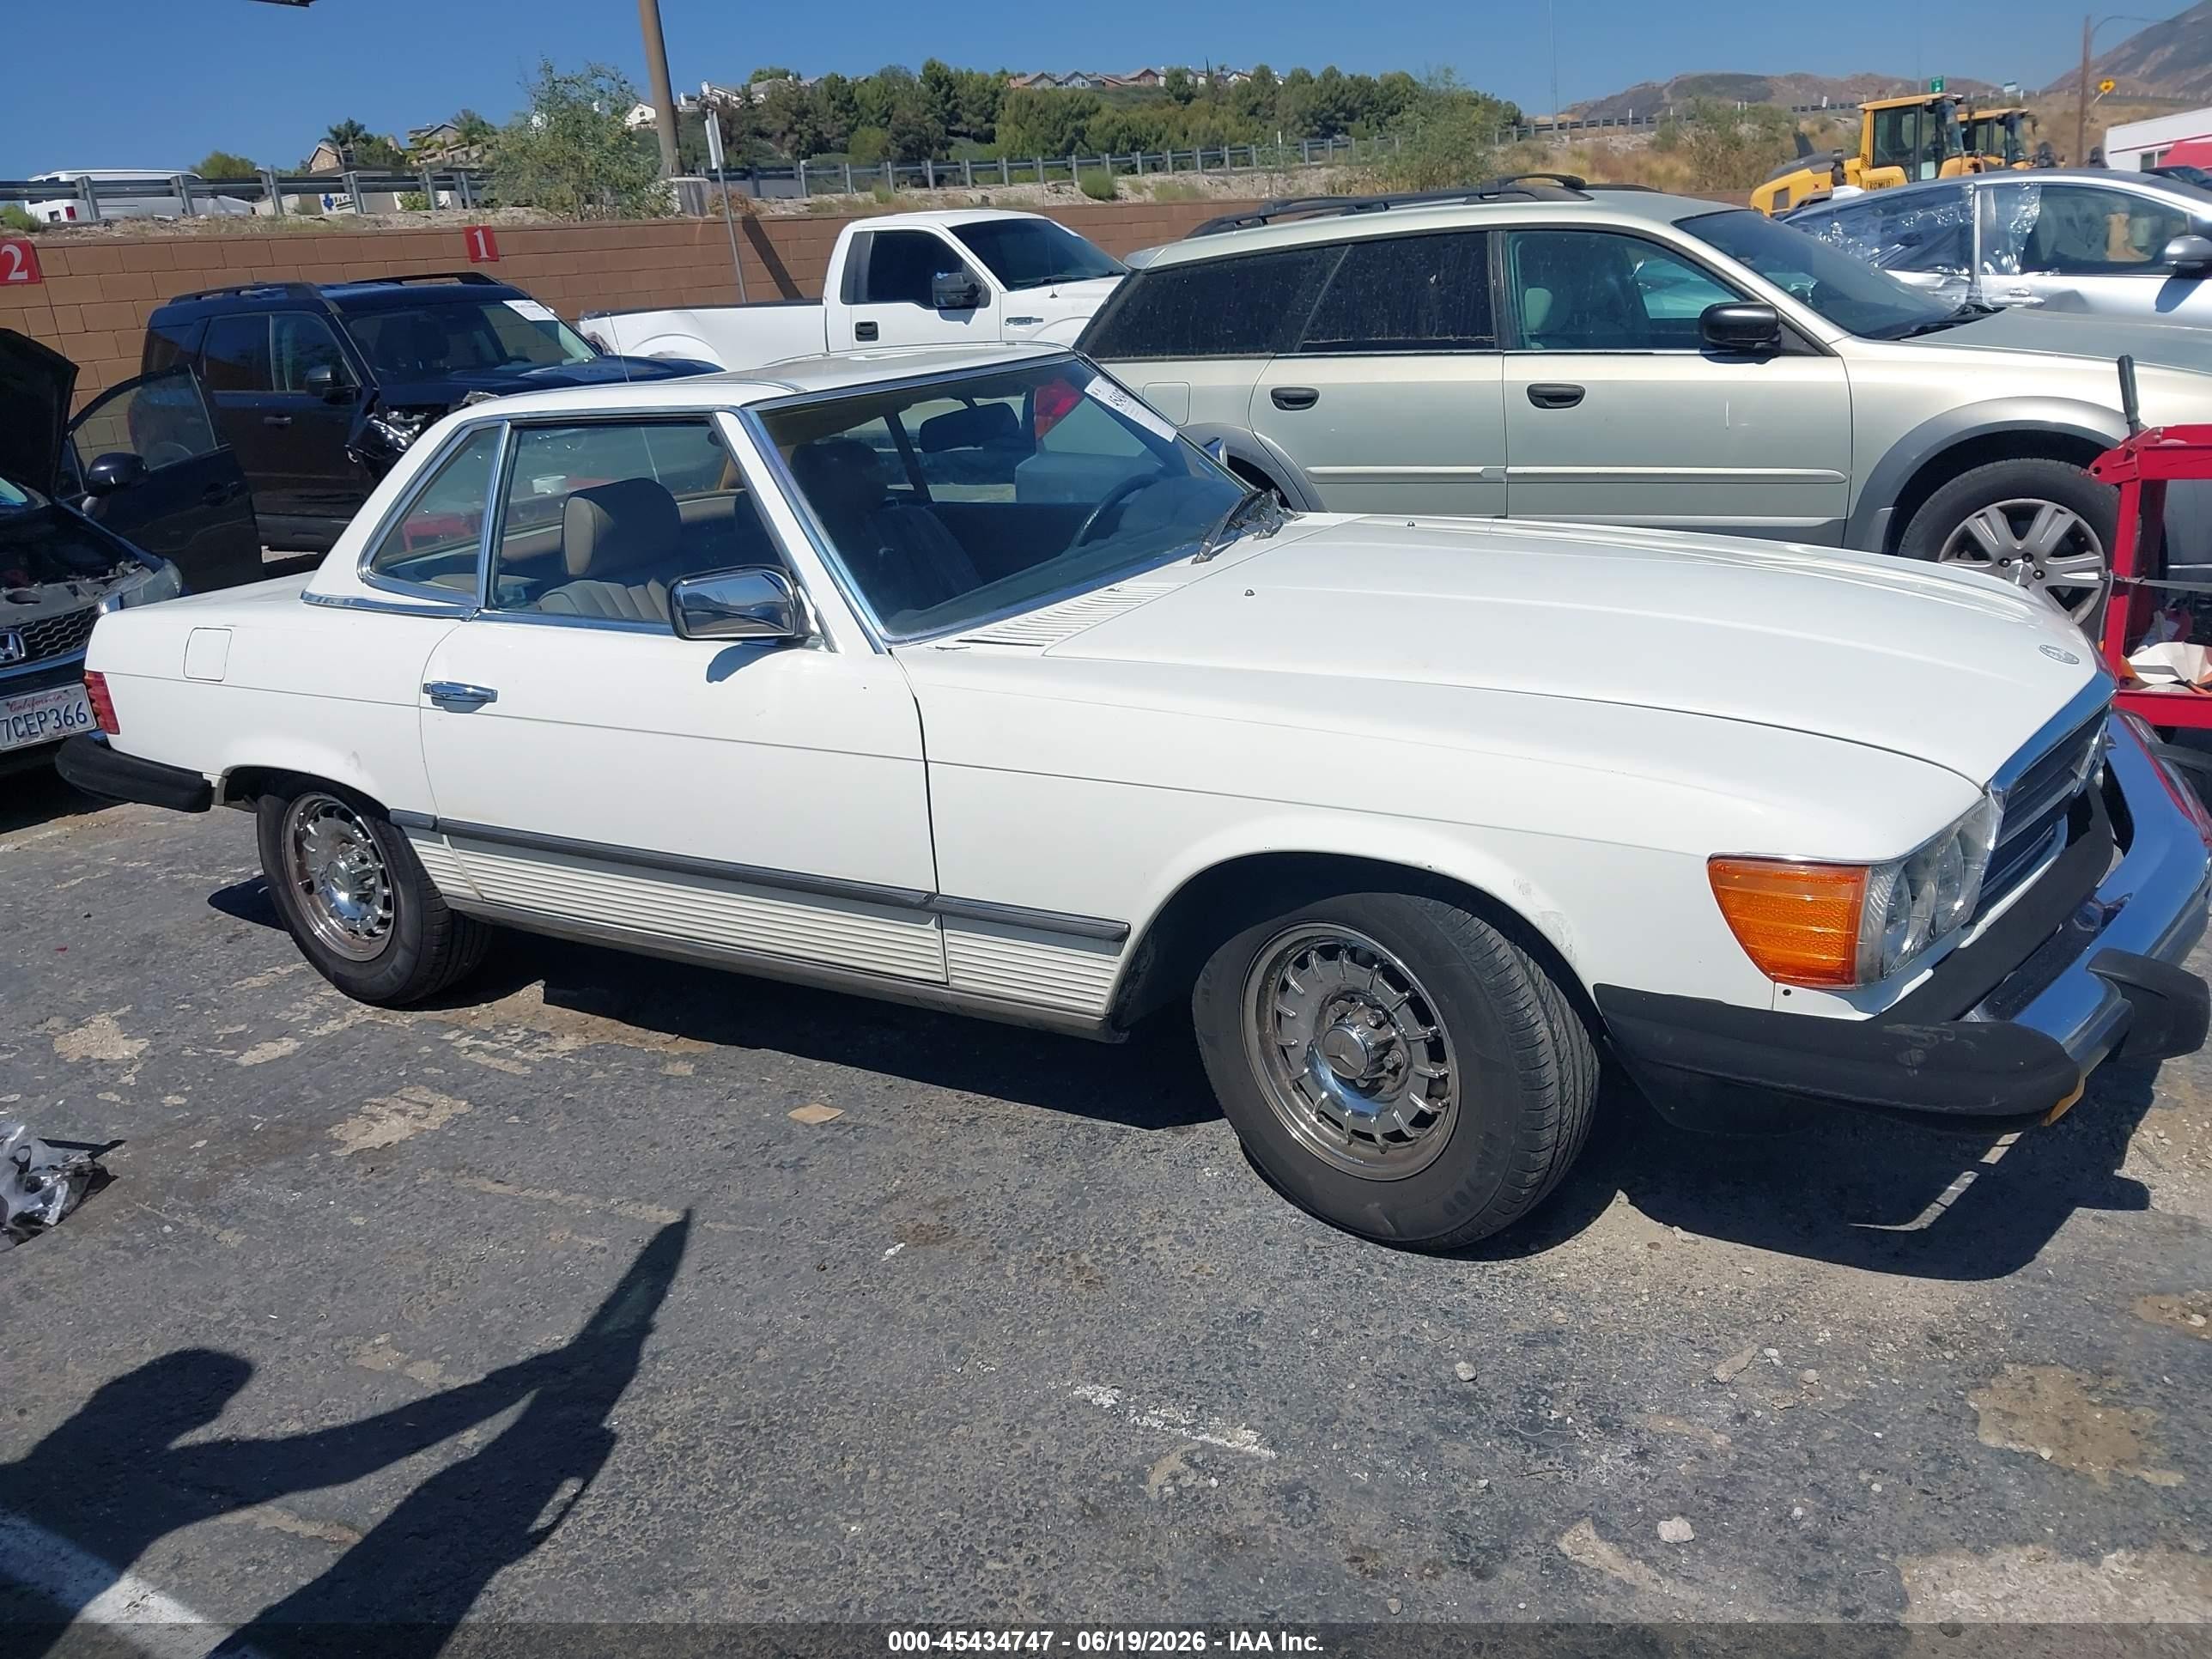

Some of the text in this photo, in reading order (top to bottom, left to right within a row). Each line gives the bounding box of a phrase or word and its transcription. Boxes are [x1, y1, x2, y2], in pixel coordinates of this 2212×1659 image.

[1, 243, 28, 281] 2
[473, 229, 490, 258] 1
[0, 701, 88, 742] 7CEP366
